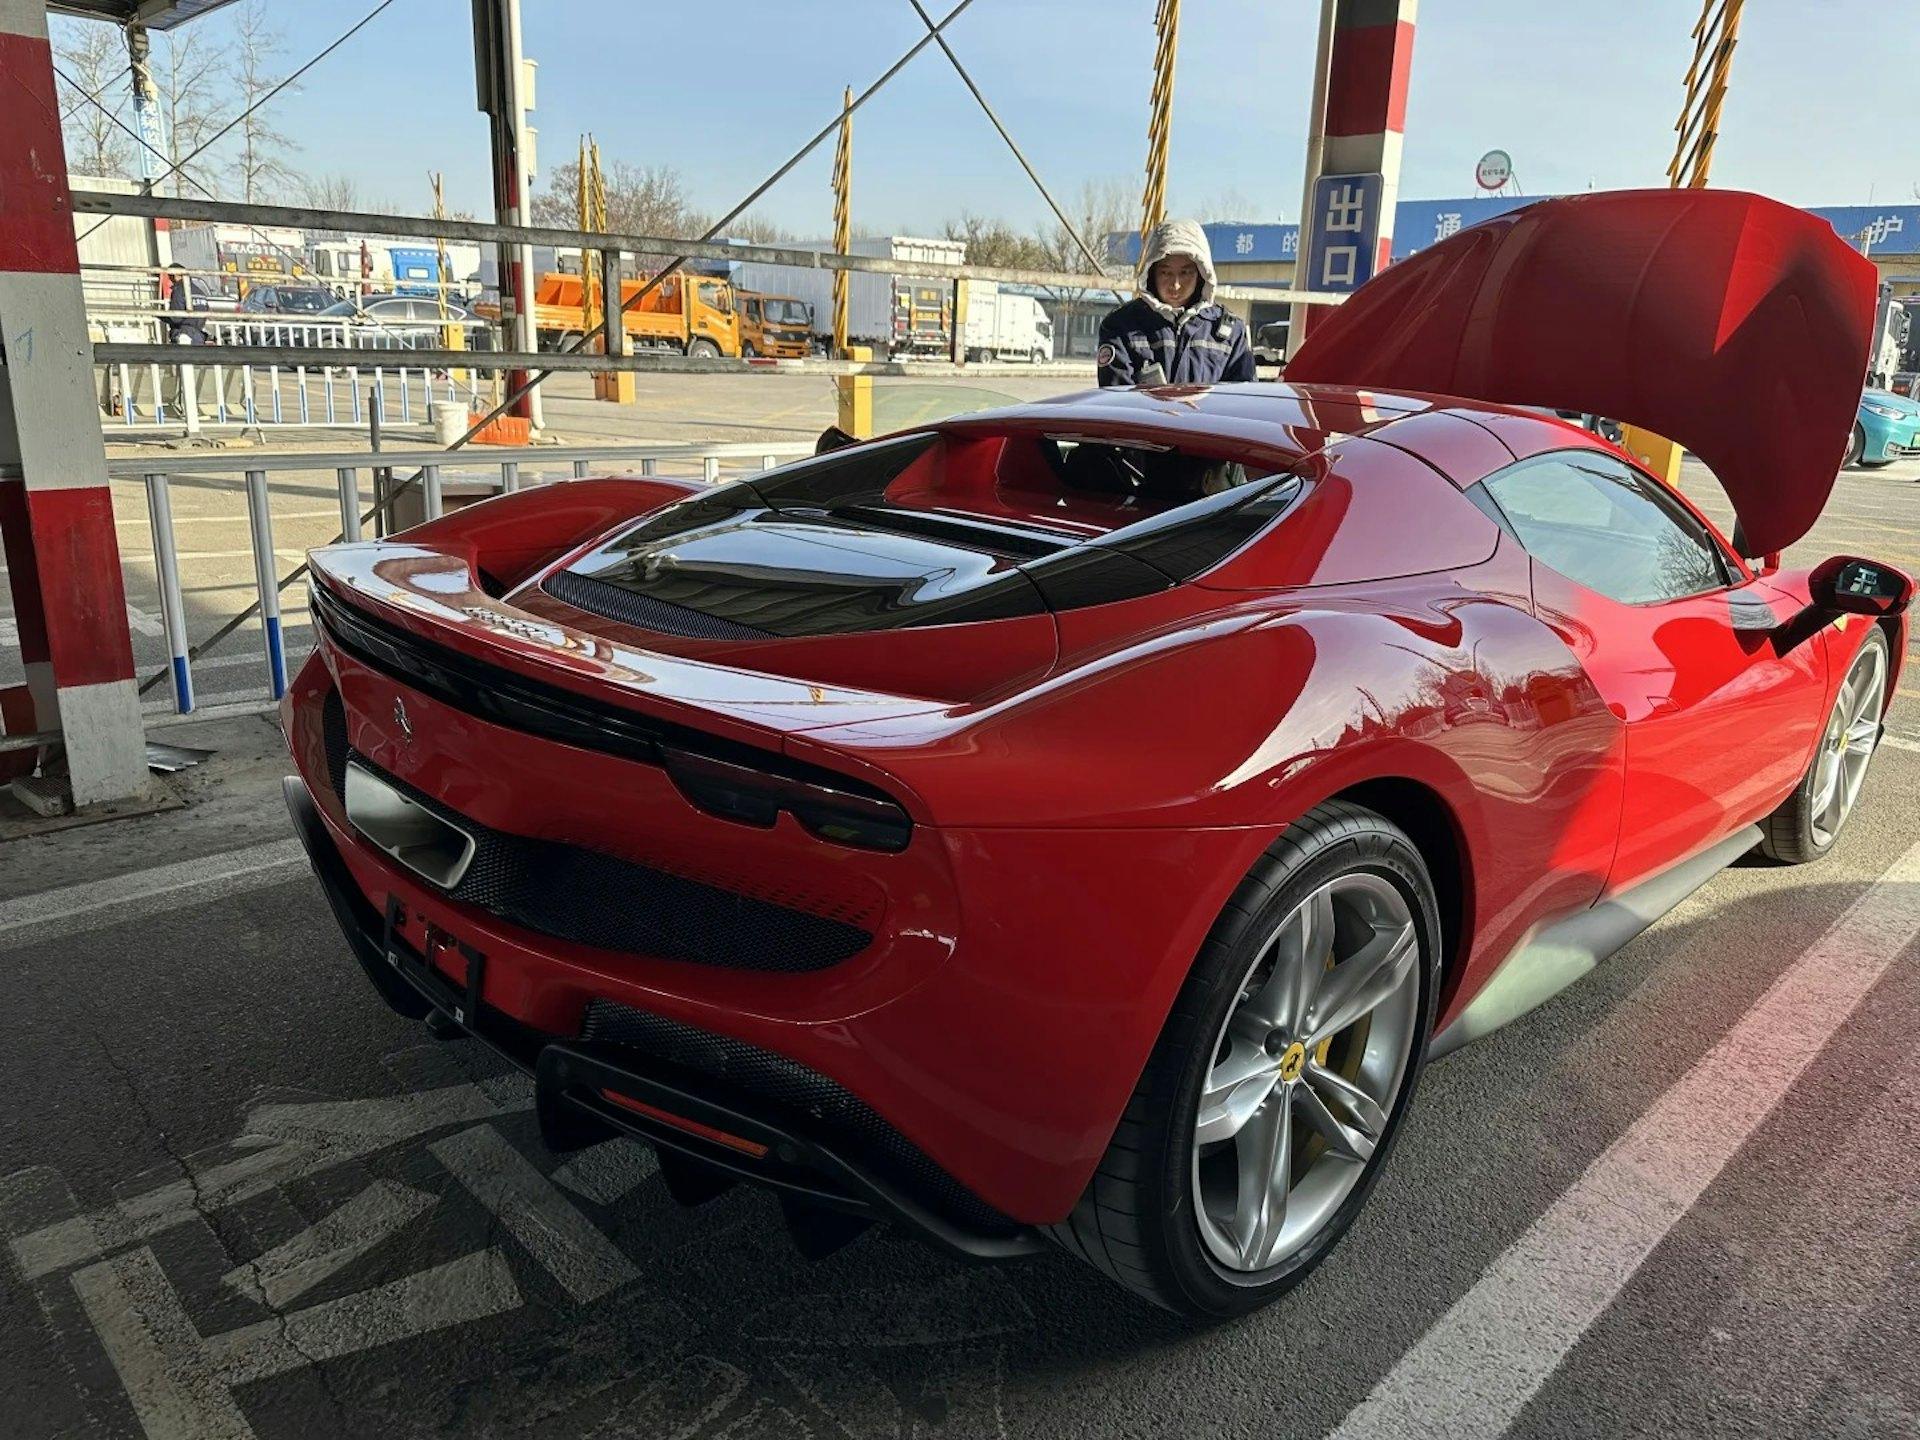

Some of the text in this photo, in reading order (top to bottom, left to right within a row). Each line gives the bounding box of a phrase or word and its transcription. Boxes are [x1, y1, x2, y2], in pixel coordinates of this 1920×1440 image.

[1235, 212, 1904, 254] 都 的 通 护
[1322, 184, 1365, 286] 出口
